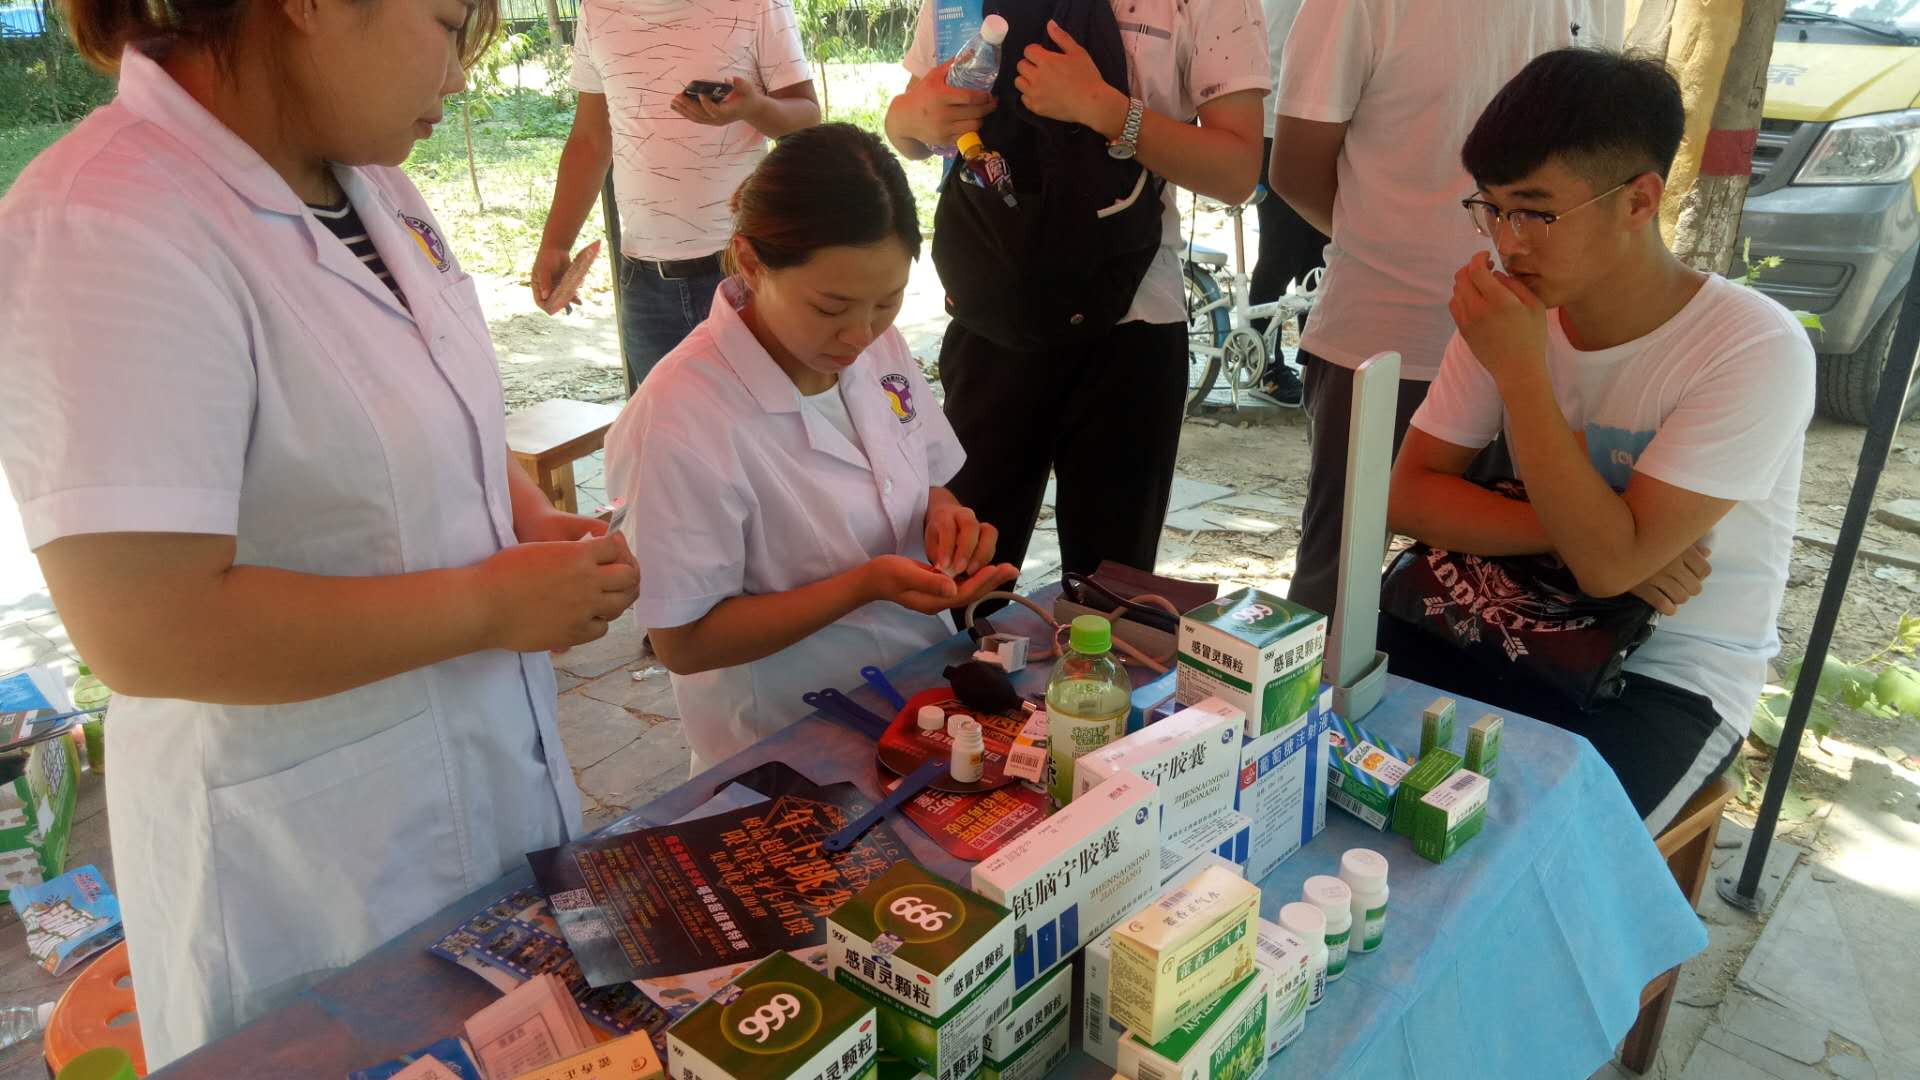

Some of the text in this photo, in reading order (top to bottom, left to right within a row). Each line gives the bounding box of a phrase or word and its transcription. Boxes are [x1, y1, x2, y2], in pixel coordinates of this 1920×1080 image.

[1191, 640, 1244, 674] 感冒灵颗粒
[1273, 633, 1323, 674] 感冒灵颗粒
[1141, 741, 1208, 787] 宁胶囊
[1012, 826, 1120, 921] 镇脑宁胶囊
[845, 947, 931, 1009] 感冒灵颗粒
[953, 944, 1004, 998] 感冒灵颗粒
[738, 993, 801, 1044] 999
[1014, 994, 1062, 1044] 感冒灵颗粒
